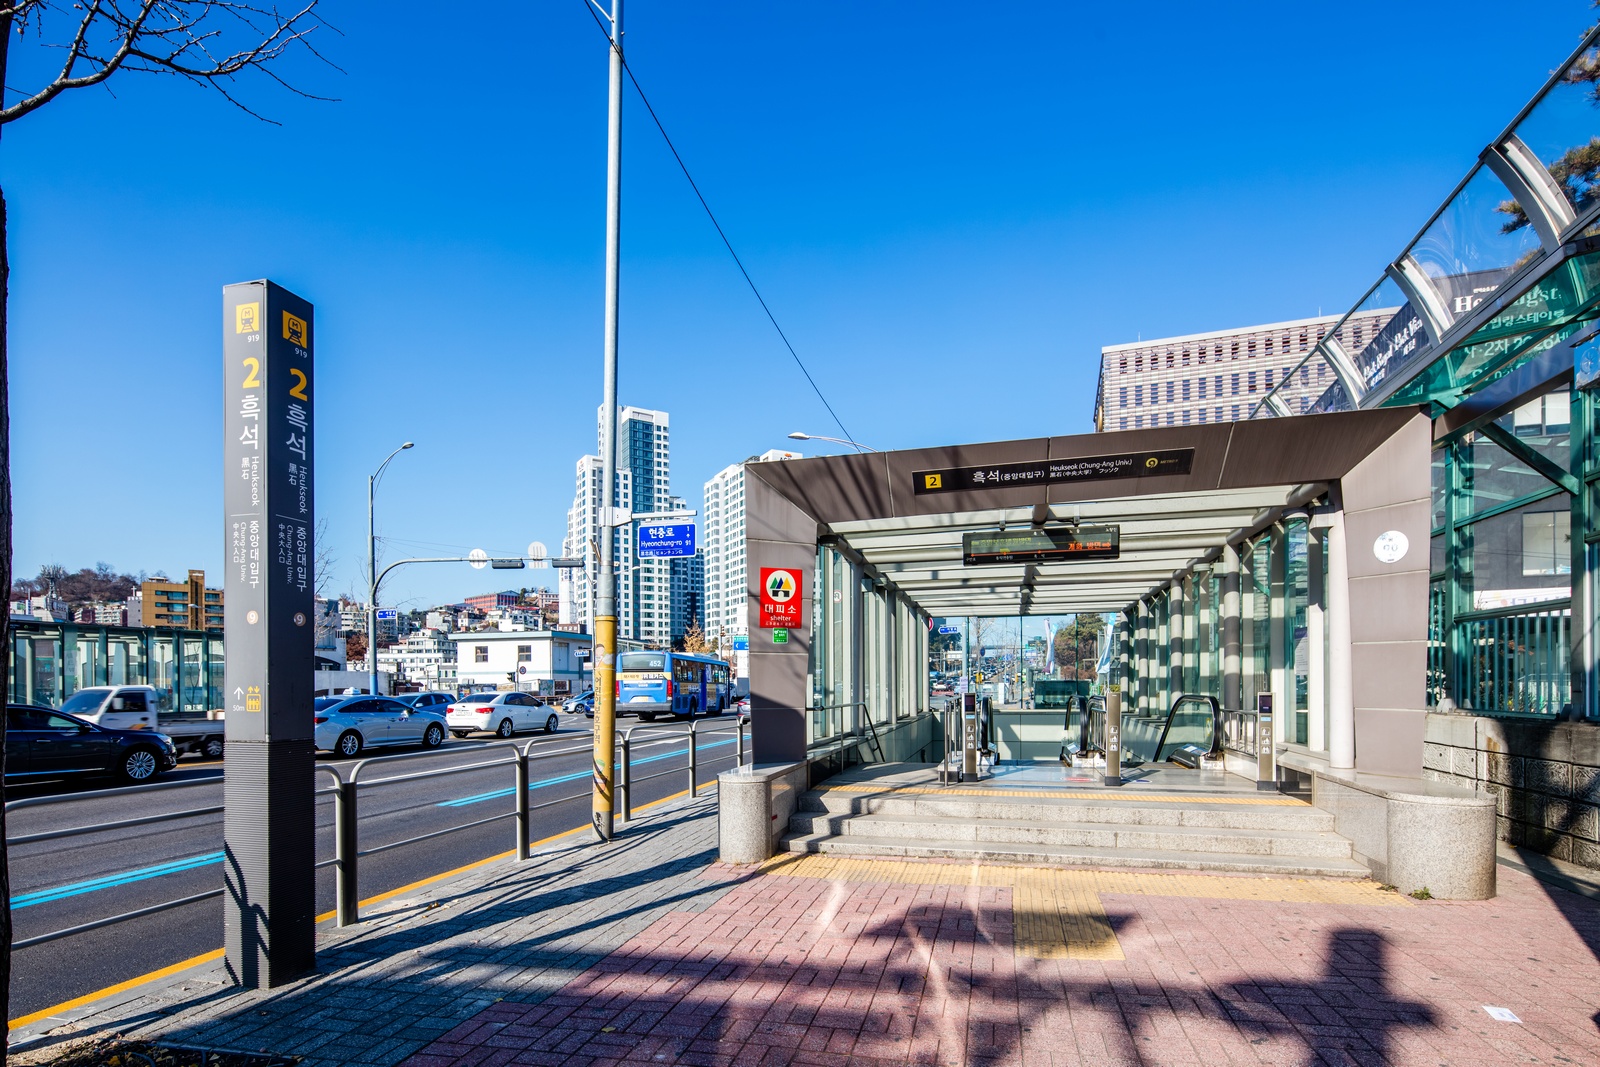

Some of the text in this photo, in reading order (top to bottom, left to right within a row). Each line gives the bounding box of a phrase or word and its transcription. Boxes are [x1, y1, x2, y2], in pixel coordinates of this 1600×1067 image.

[247, 334, 260, 343] 919
[294, 347, 308, 358] 919
[242, 357, 260, 389] 2
[289, 368, 308, 402] 2
[239, 394, 261, 450] 흑석
[286, 403, 309, 461] 흑석
[251, 456, 260, 507] Heukseok
[929, 476, 938, 487] 2
[1049, 463, 1078, 472] Heukseok
[1078, 460, 1115, 470] (Chung-Ang
[299, 465, 308, 514] Heukseok
[278, 523, 286, 564] 中央大入口
[285, 525, 294, 565] Chung-Ang
[640, 540, 683, 548] Hyeonchung-ro
[648, 527, 675, 539] 현충로
[249, 520, 260, 589] 중앙대입구
[296, 527, 308, 592] 중앙대입구
[764, 603, 797, 614] 대피소
